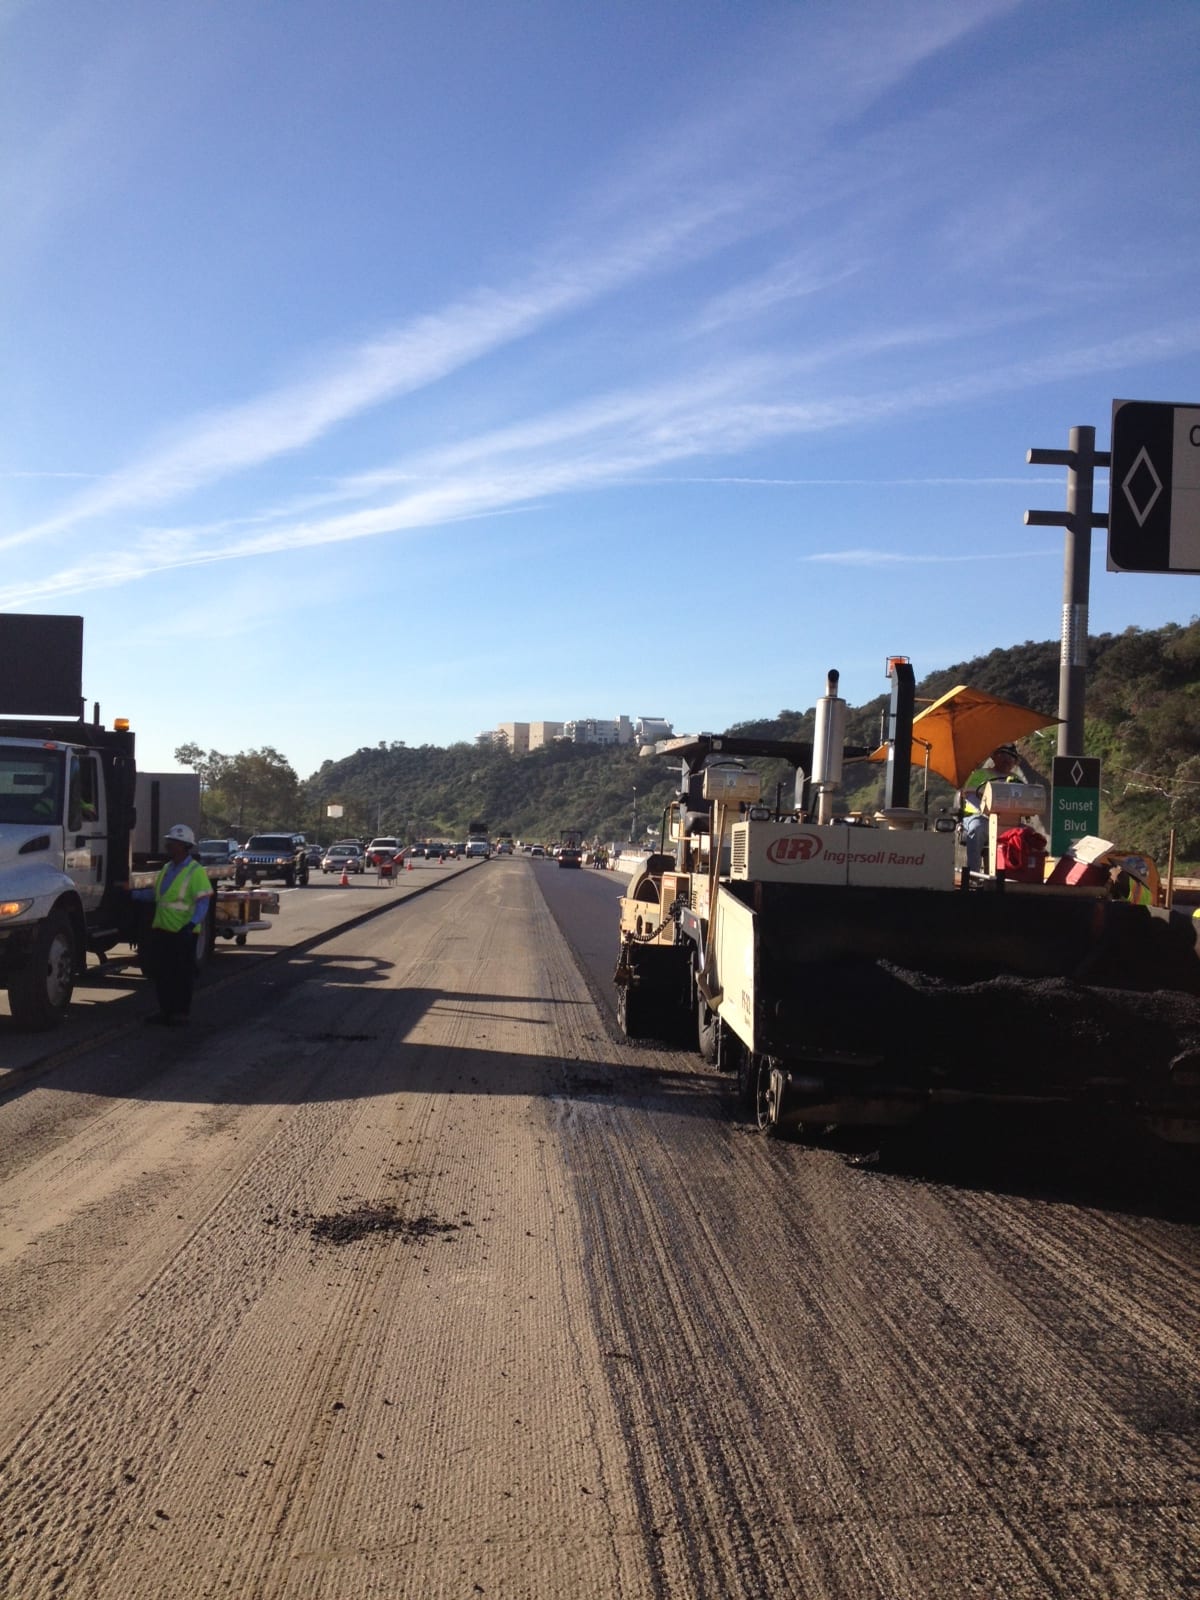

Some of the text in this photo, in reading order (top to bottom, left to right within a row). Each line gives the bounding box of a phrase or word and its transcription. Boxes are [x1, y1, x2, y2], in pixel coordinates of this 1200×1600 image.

[1059, 798, 1093, 811] Sunset
[1064, 819, 1087, 832] Blvd
[775, 838, 814, 860] IR
[823, 850, 925, 866] Ingersoll Rand
